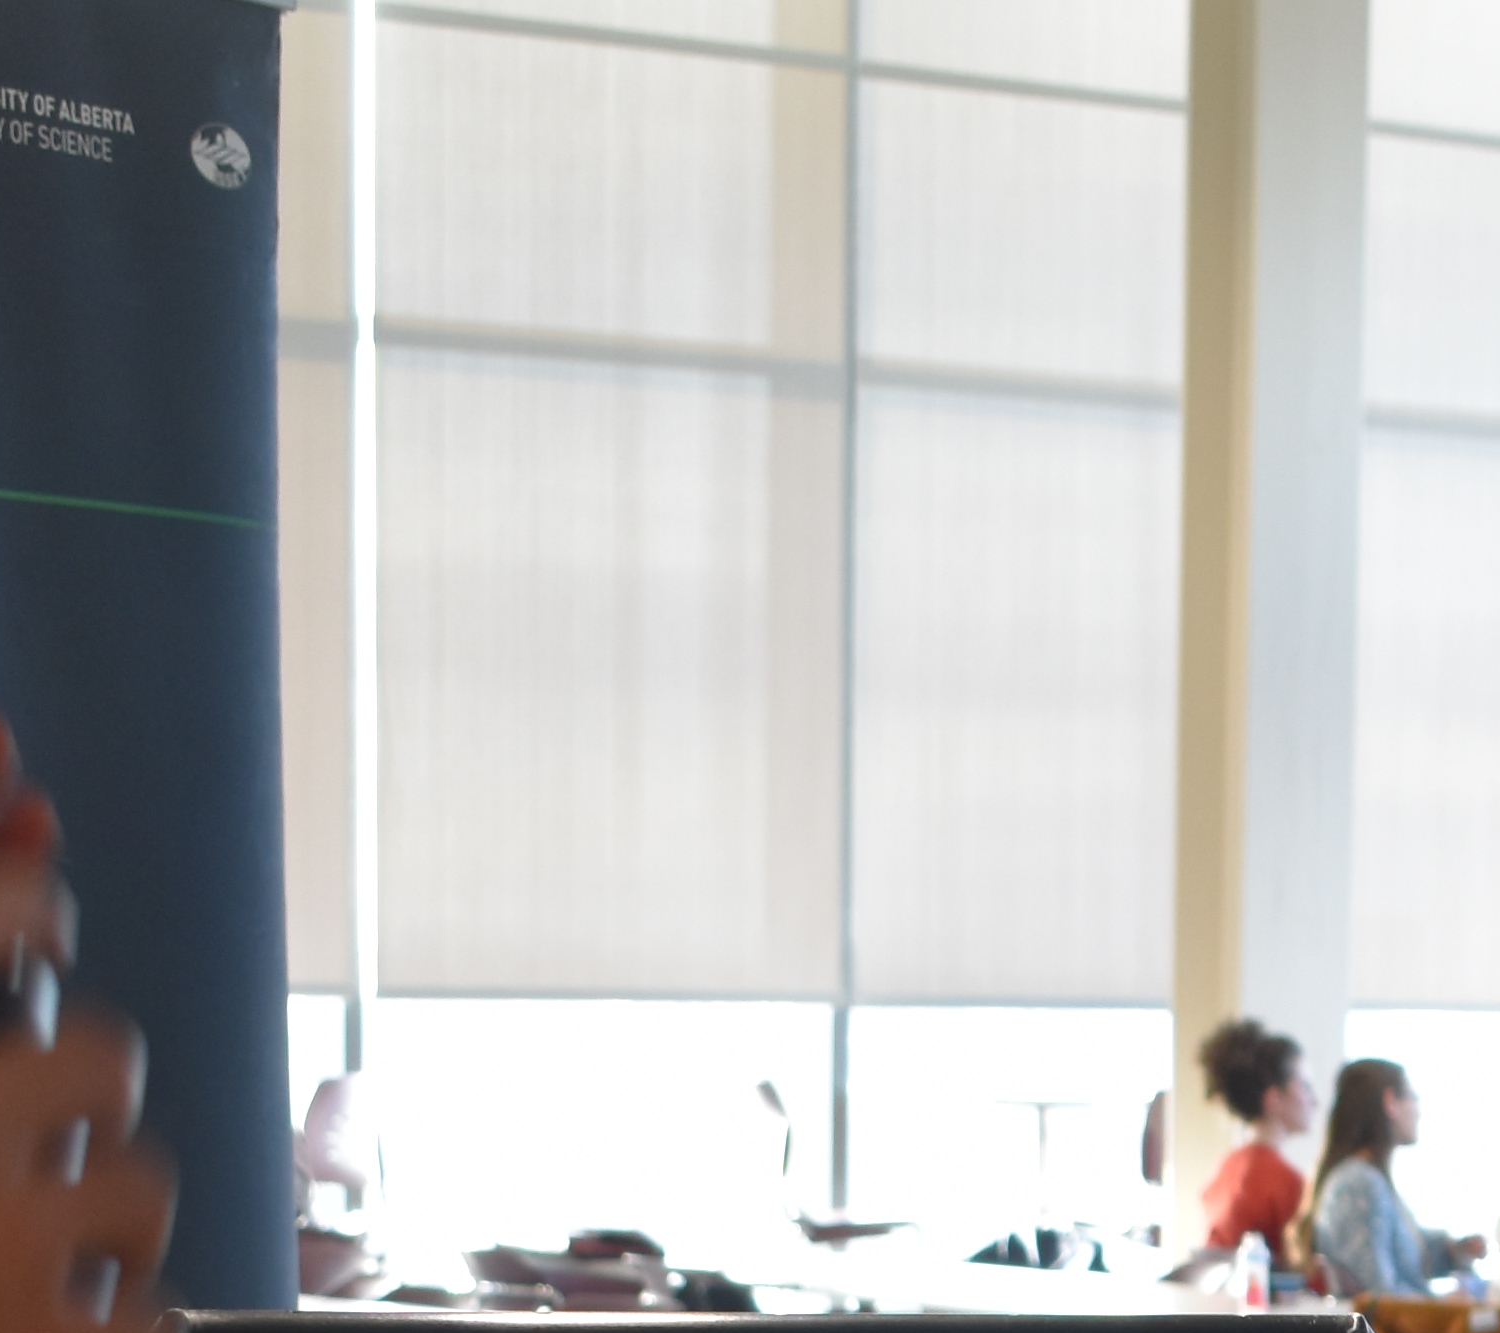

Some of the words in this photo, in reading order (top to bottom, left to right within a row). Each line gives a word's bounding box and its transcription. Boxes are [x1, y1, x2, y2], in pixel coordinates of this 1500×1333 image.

[34, 94, 56, 117] OF
[59, 99, 135, 135] ALBERTA
[10, 121, 33, 145] OF
[38, 125, 114, 163] SCIENCE
